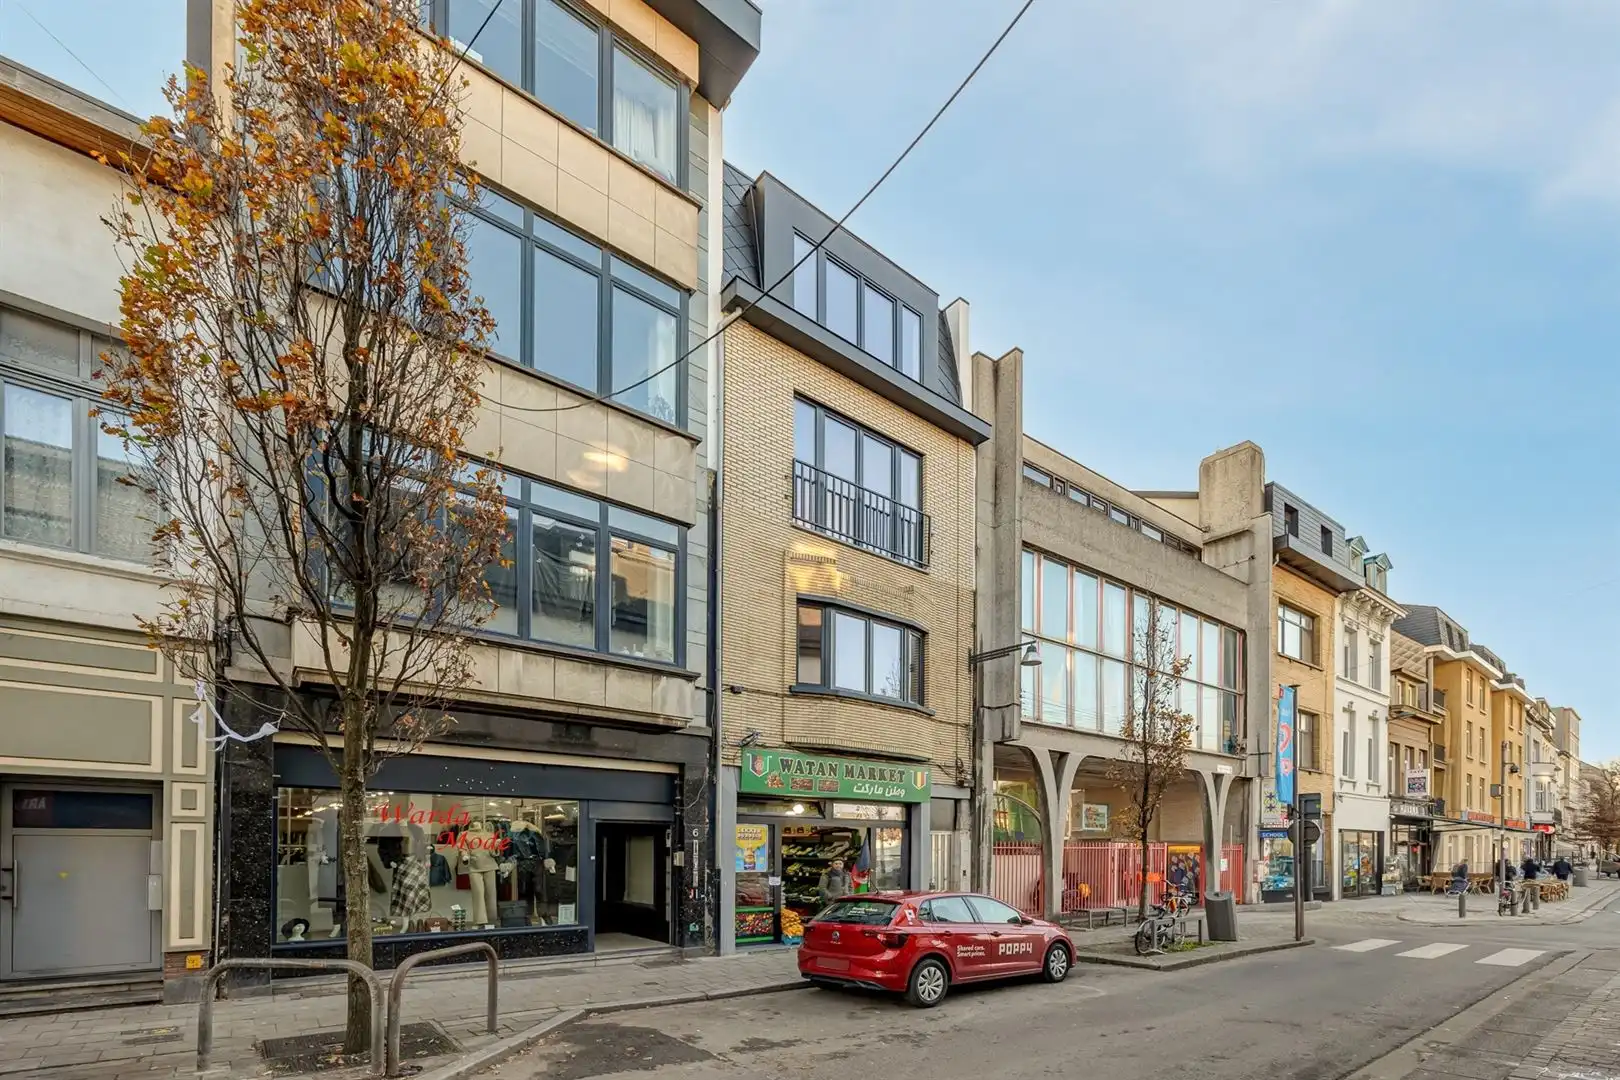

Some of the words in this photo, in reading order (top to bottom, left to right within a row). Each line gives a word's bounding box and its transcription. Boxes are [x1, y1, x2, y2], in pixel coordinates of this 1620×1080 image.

[779, 757, 839, 778] WATAN
[843, 763, 906, 783] MARKET
[373, 801, 470, 827] Warda
[436, 828, 512, 852] Mode
[692, 828, 699, 837] 6
[956, 944, 974, 952] Shared
[998, 942, 1033, 956] POPPY
